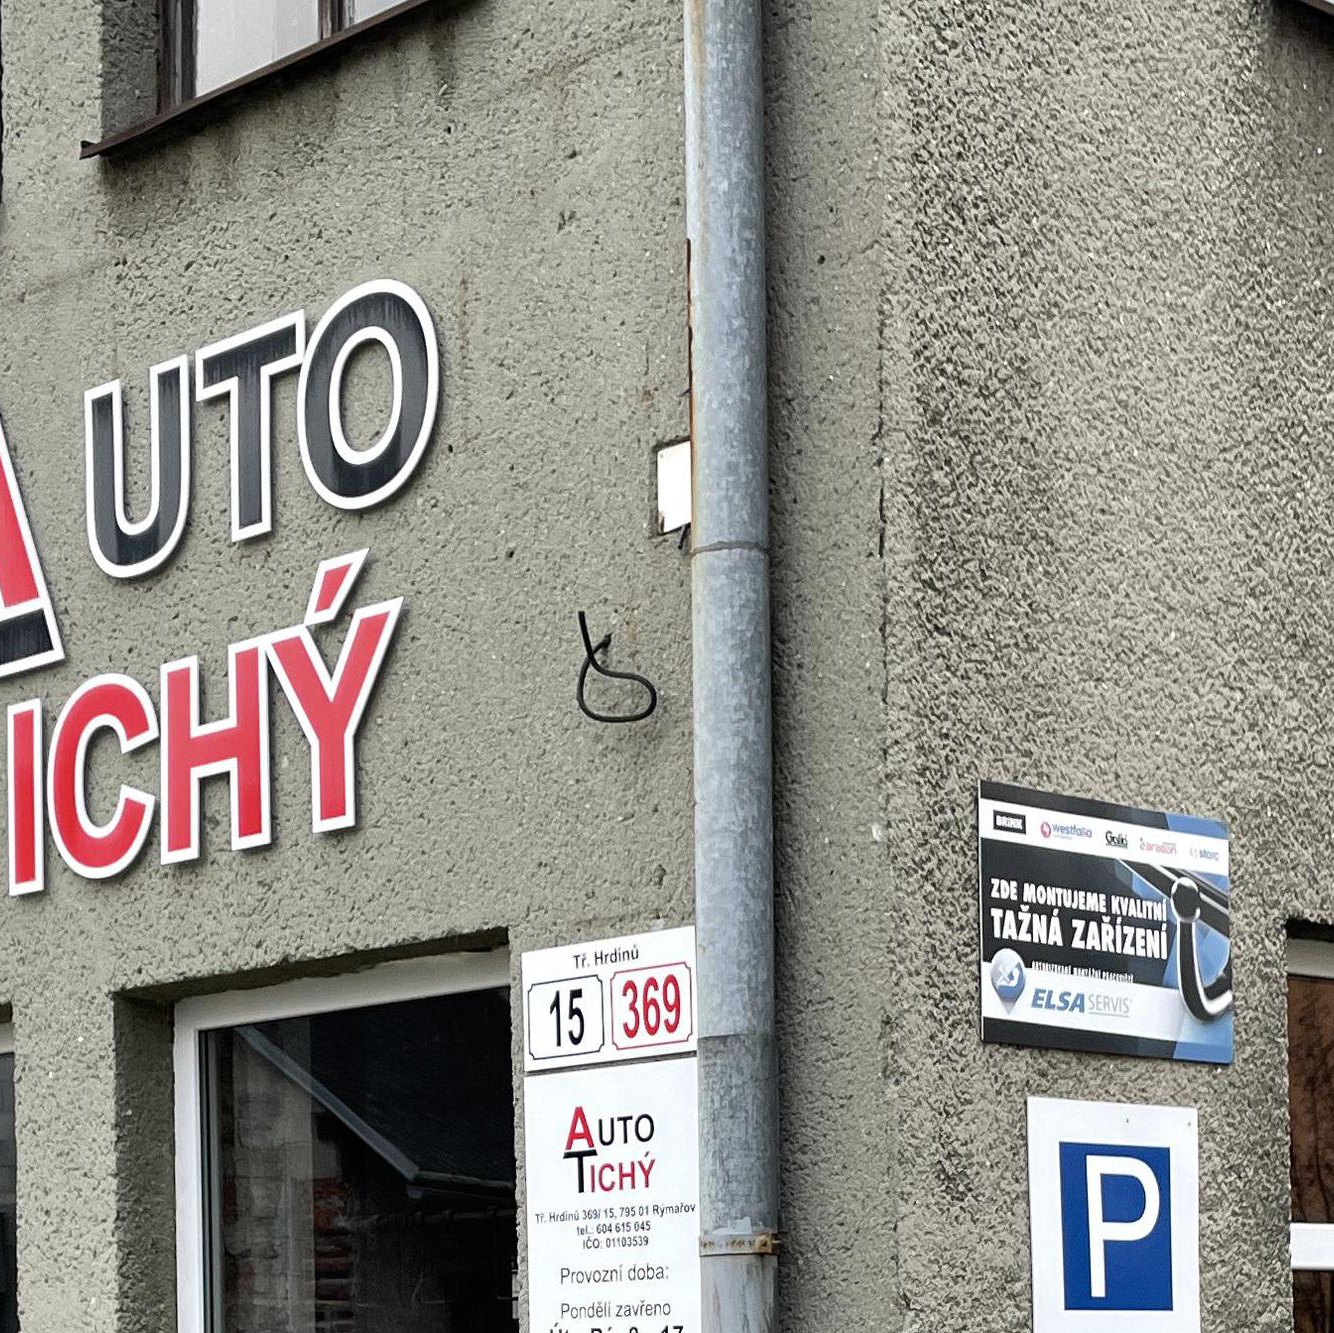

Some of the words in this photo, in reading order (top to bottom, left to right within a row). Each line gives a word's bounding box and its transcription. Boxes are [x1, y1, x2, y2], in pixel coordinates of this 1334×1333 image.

[990, 878, 1017, 900] ZDE
[1023, 883, 1107, 913] MONTUJEME
[1111, 895, 1167, 922] KVALITNÍ
[990, 904, 1064, 947] TAŽNÁ
[1071, 915, 1168, 960] ZAŘÍZENÍ
[573, 951, 590, 969] Tř.
[594, 944, 639, 966] Hrdinů
[549, 988, 585, 1047] 15
[622, 974, 681, 1039] 369
[1031, 987, 1085, 1013] ELSA
[1088, 993, 1130, 1014] SERVIS
[565, 1107, 656, 1151] AUTO
[562, 1150, 657, 1194] TICHÝ
[596, 1223, 612, 1235] 604
[615, 1221, 631, 1233] 615
[634, 1220, 651, 1232] 045
[620, 1206, 636, 1218] 795
[638, 1205, 649, 1217] 01
[652, 1202, 696, 1218] Rýmařov
[1085, 1154, 1160, 1298] P
[560, 1264, 623, 1285] Provozní
[628, 1262, 669, 1281] doba:
[560, 1301, 612, 1319] Pondělí
[615, 1300, 671, 1318] zavřeno
